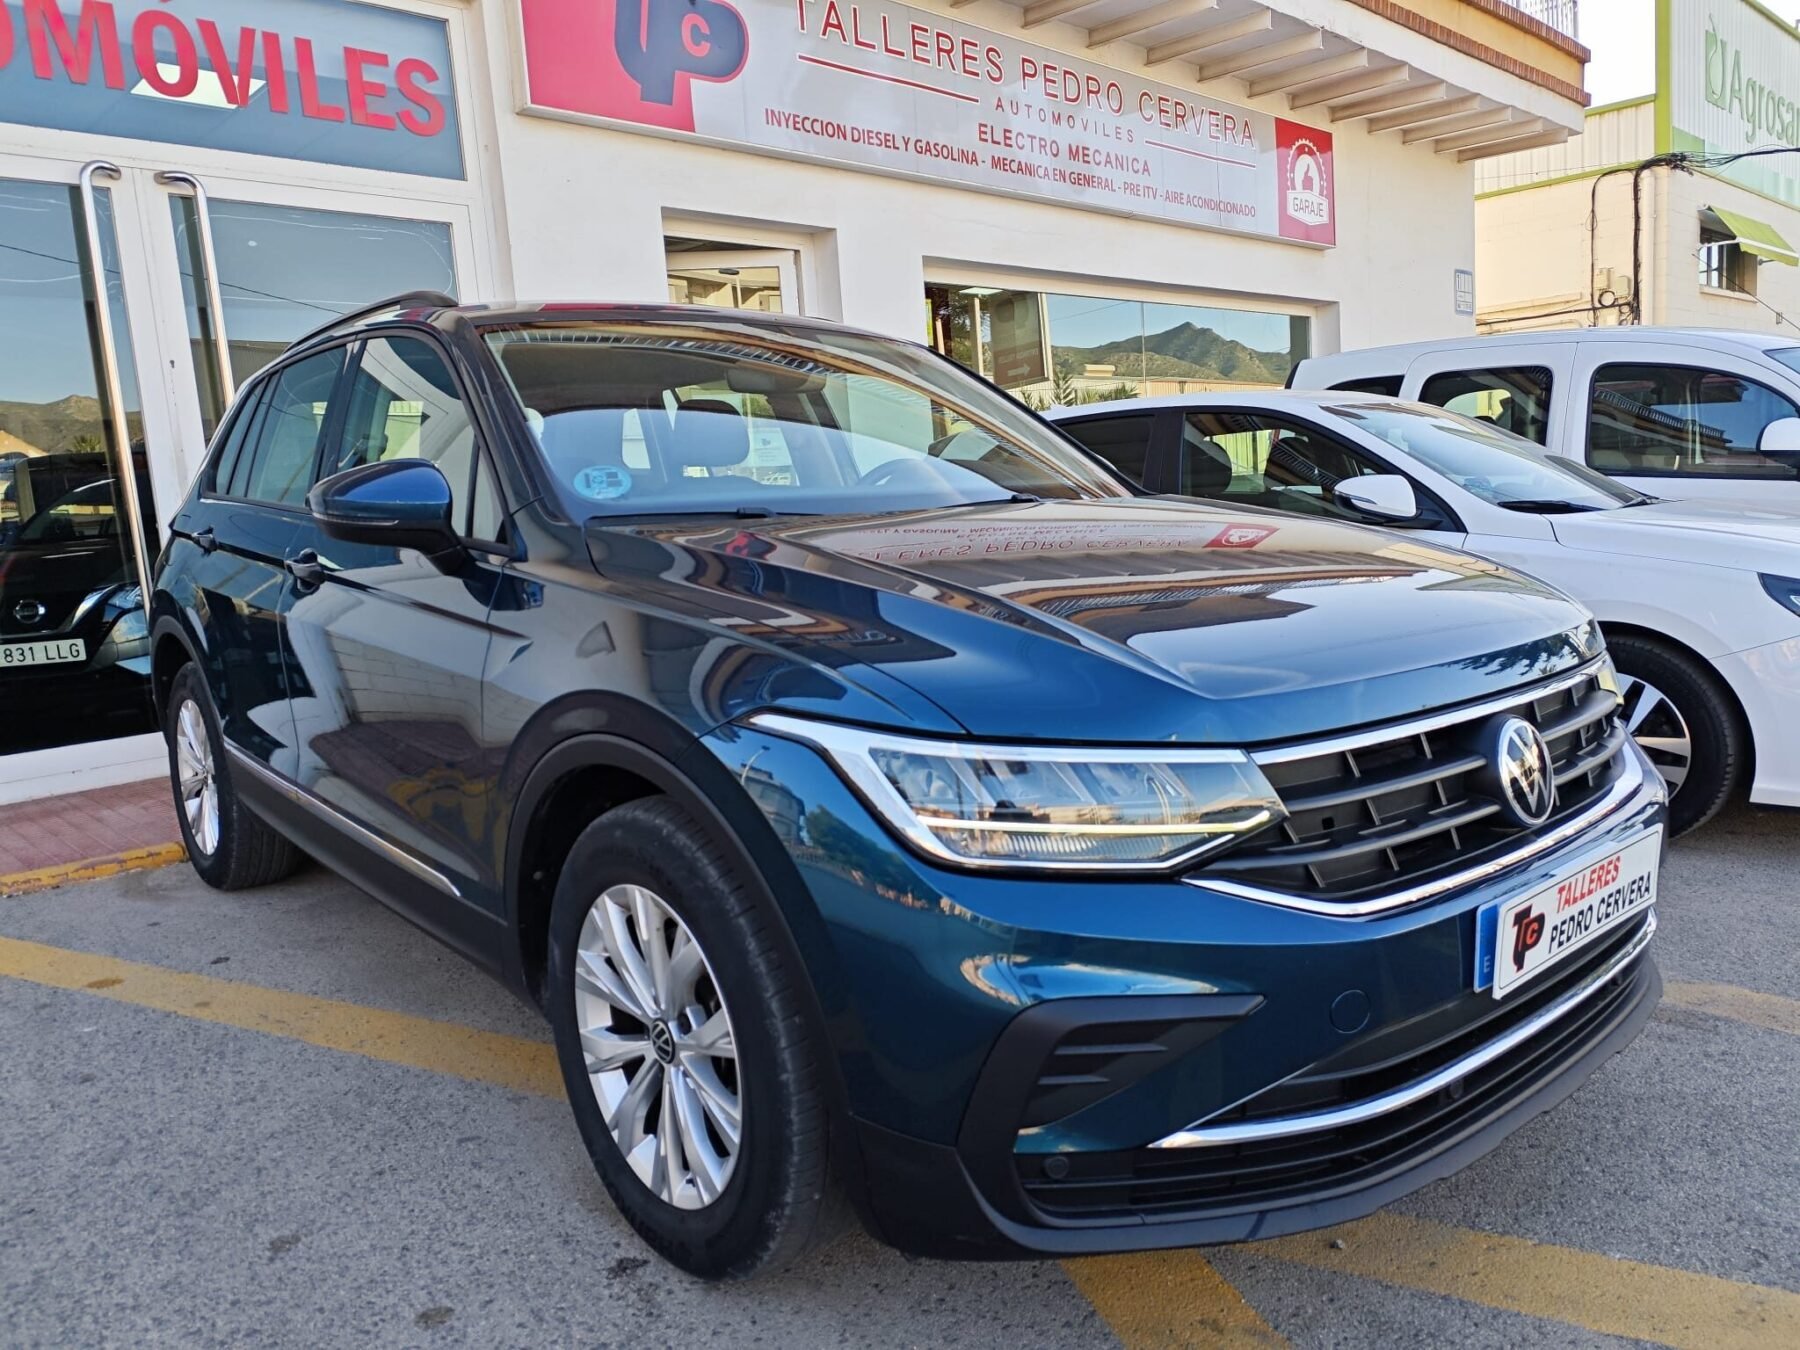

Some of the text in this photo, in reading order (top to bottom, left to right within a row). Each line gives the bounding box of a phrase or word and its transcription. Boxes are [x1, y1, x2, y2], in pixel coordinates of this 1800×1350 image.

[0, 0, 446, 137] MÓVILES
[797, 0, 1256, 150] TALLERES PEDRO CERVERA
[995, 96, 1134, 143] AUTOMOVILES
[1728, 49, 1799, 149] Agrosa
[764, 108, 847, 141] INYECCION
[851, 127, 900, 150] DIESEL
[902, 136, 911, 152] Y
[914, 138, 979, 166] GASOLINA
[991, 155, 1050, 181] MECANICA
[1052, 168, 1066, 183] EN
[1069, 172, 1116, 192] GENERAL
[1123, 181, 1141, 198] PRE
[1143, 185, 1158, 201] ITV
[1164, 189, 1185, 205] AIRE
[1187, 194, 1256, 218] ACONDICIONADO
[978, 123, 1151, 176] ELECTRO MECANICA
[1293, 197, 1324, 218] GARAJE
[44, 643, 80, 661] LLG
[1549, 871, 1652, 954] PEDRO CERVERA
[1557, 855, 1621, 914] TALLERES
[1484, 954, 1491, 973] E
